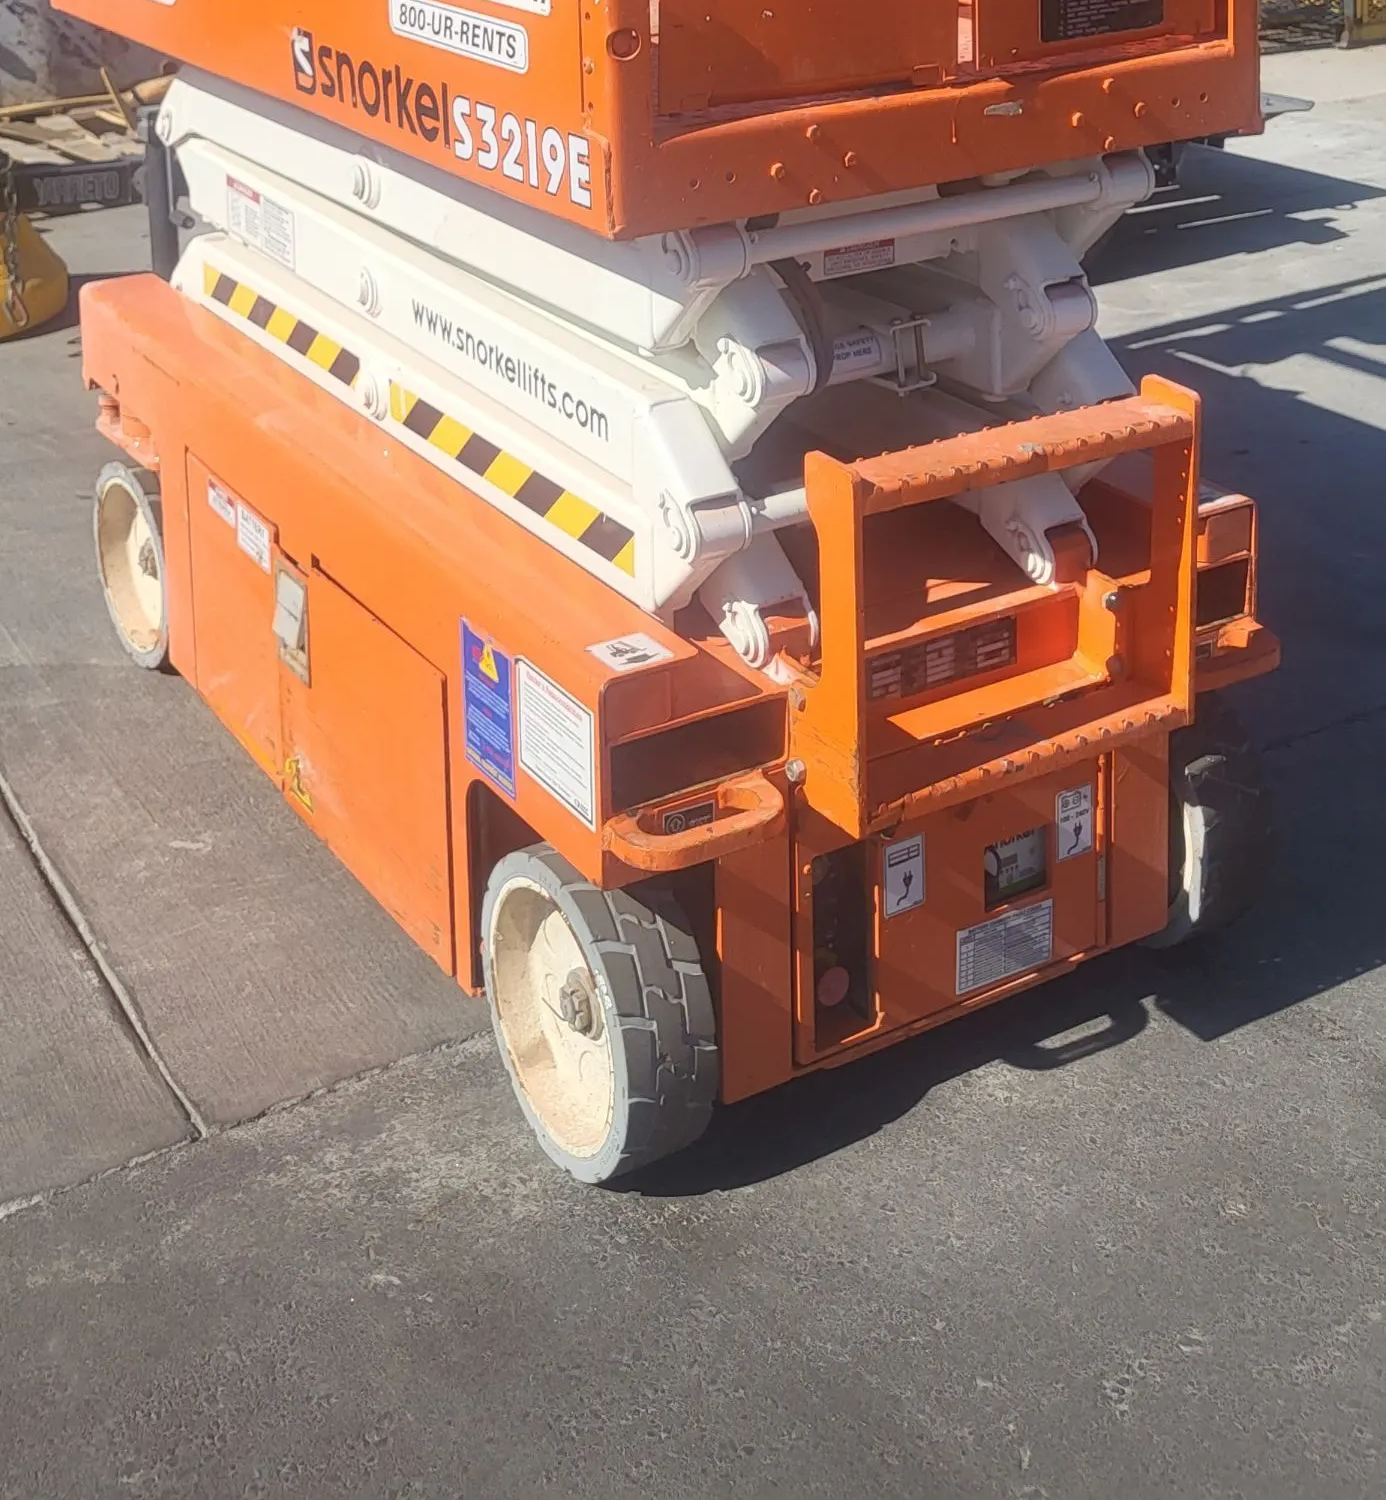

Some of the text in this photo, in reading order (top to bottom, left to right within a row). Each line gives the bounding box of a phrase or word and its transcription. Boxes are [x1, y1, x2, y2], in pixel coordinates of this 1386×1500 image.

[399, 3, 517, 60] 800-UR-RENTS
[318, 45, 451, 150] snorkel
[452, 95, 593, 211] S3219E
[411, 297, 610, 443] www.snorkellifts.com
